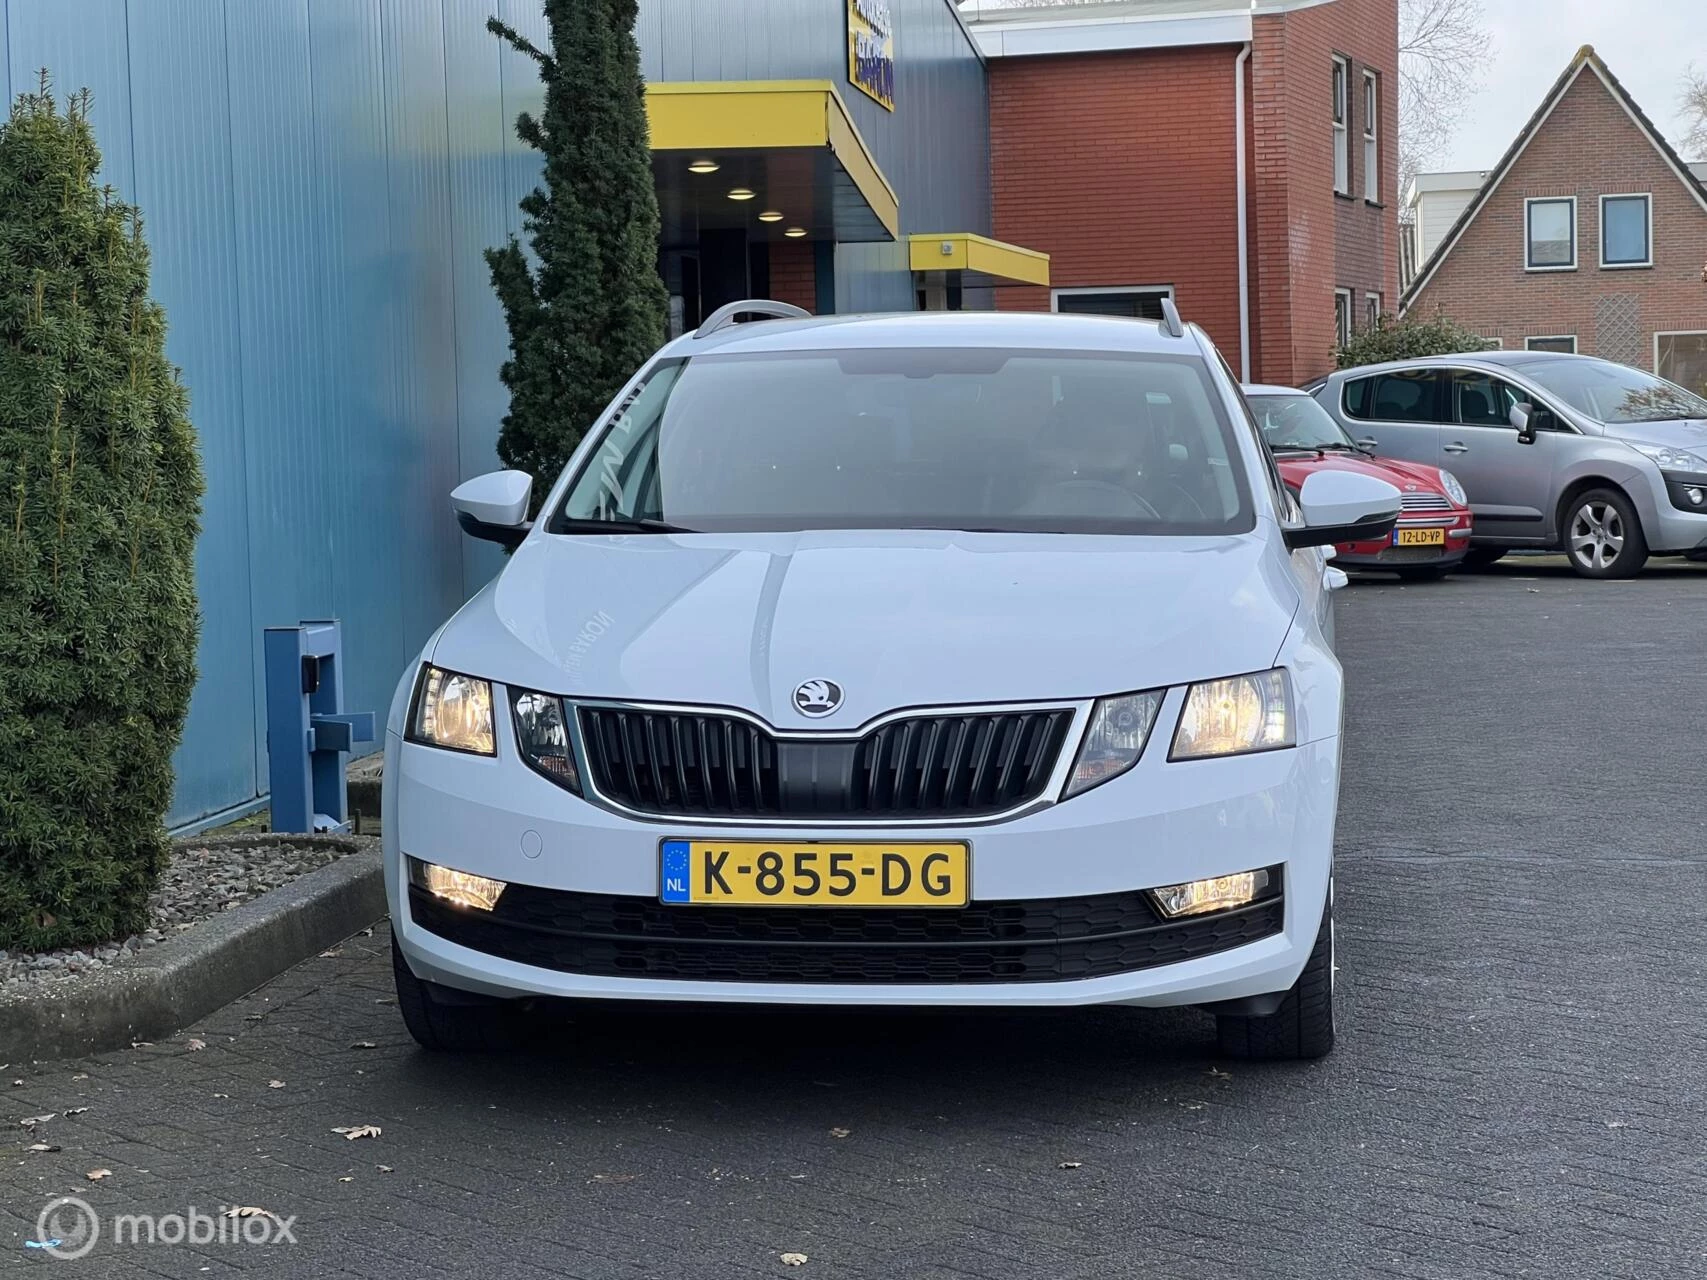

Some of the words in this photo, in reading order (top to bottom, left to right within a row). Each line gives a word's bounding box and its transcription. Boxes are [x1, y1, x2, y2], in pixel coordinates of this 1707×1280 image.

[1402, 531, 1441, 543] 12-LD-VP
[666, 878, 686, 892] NL
[704, 851, 952, 897] K-855-DG
